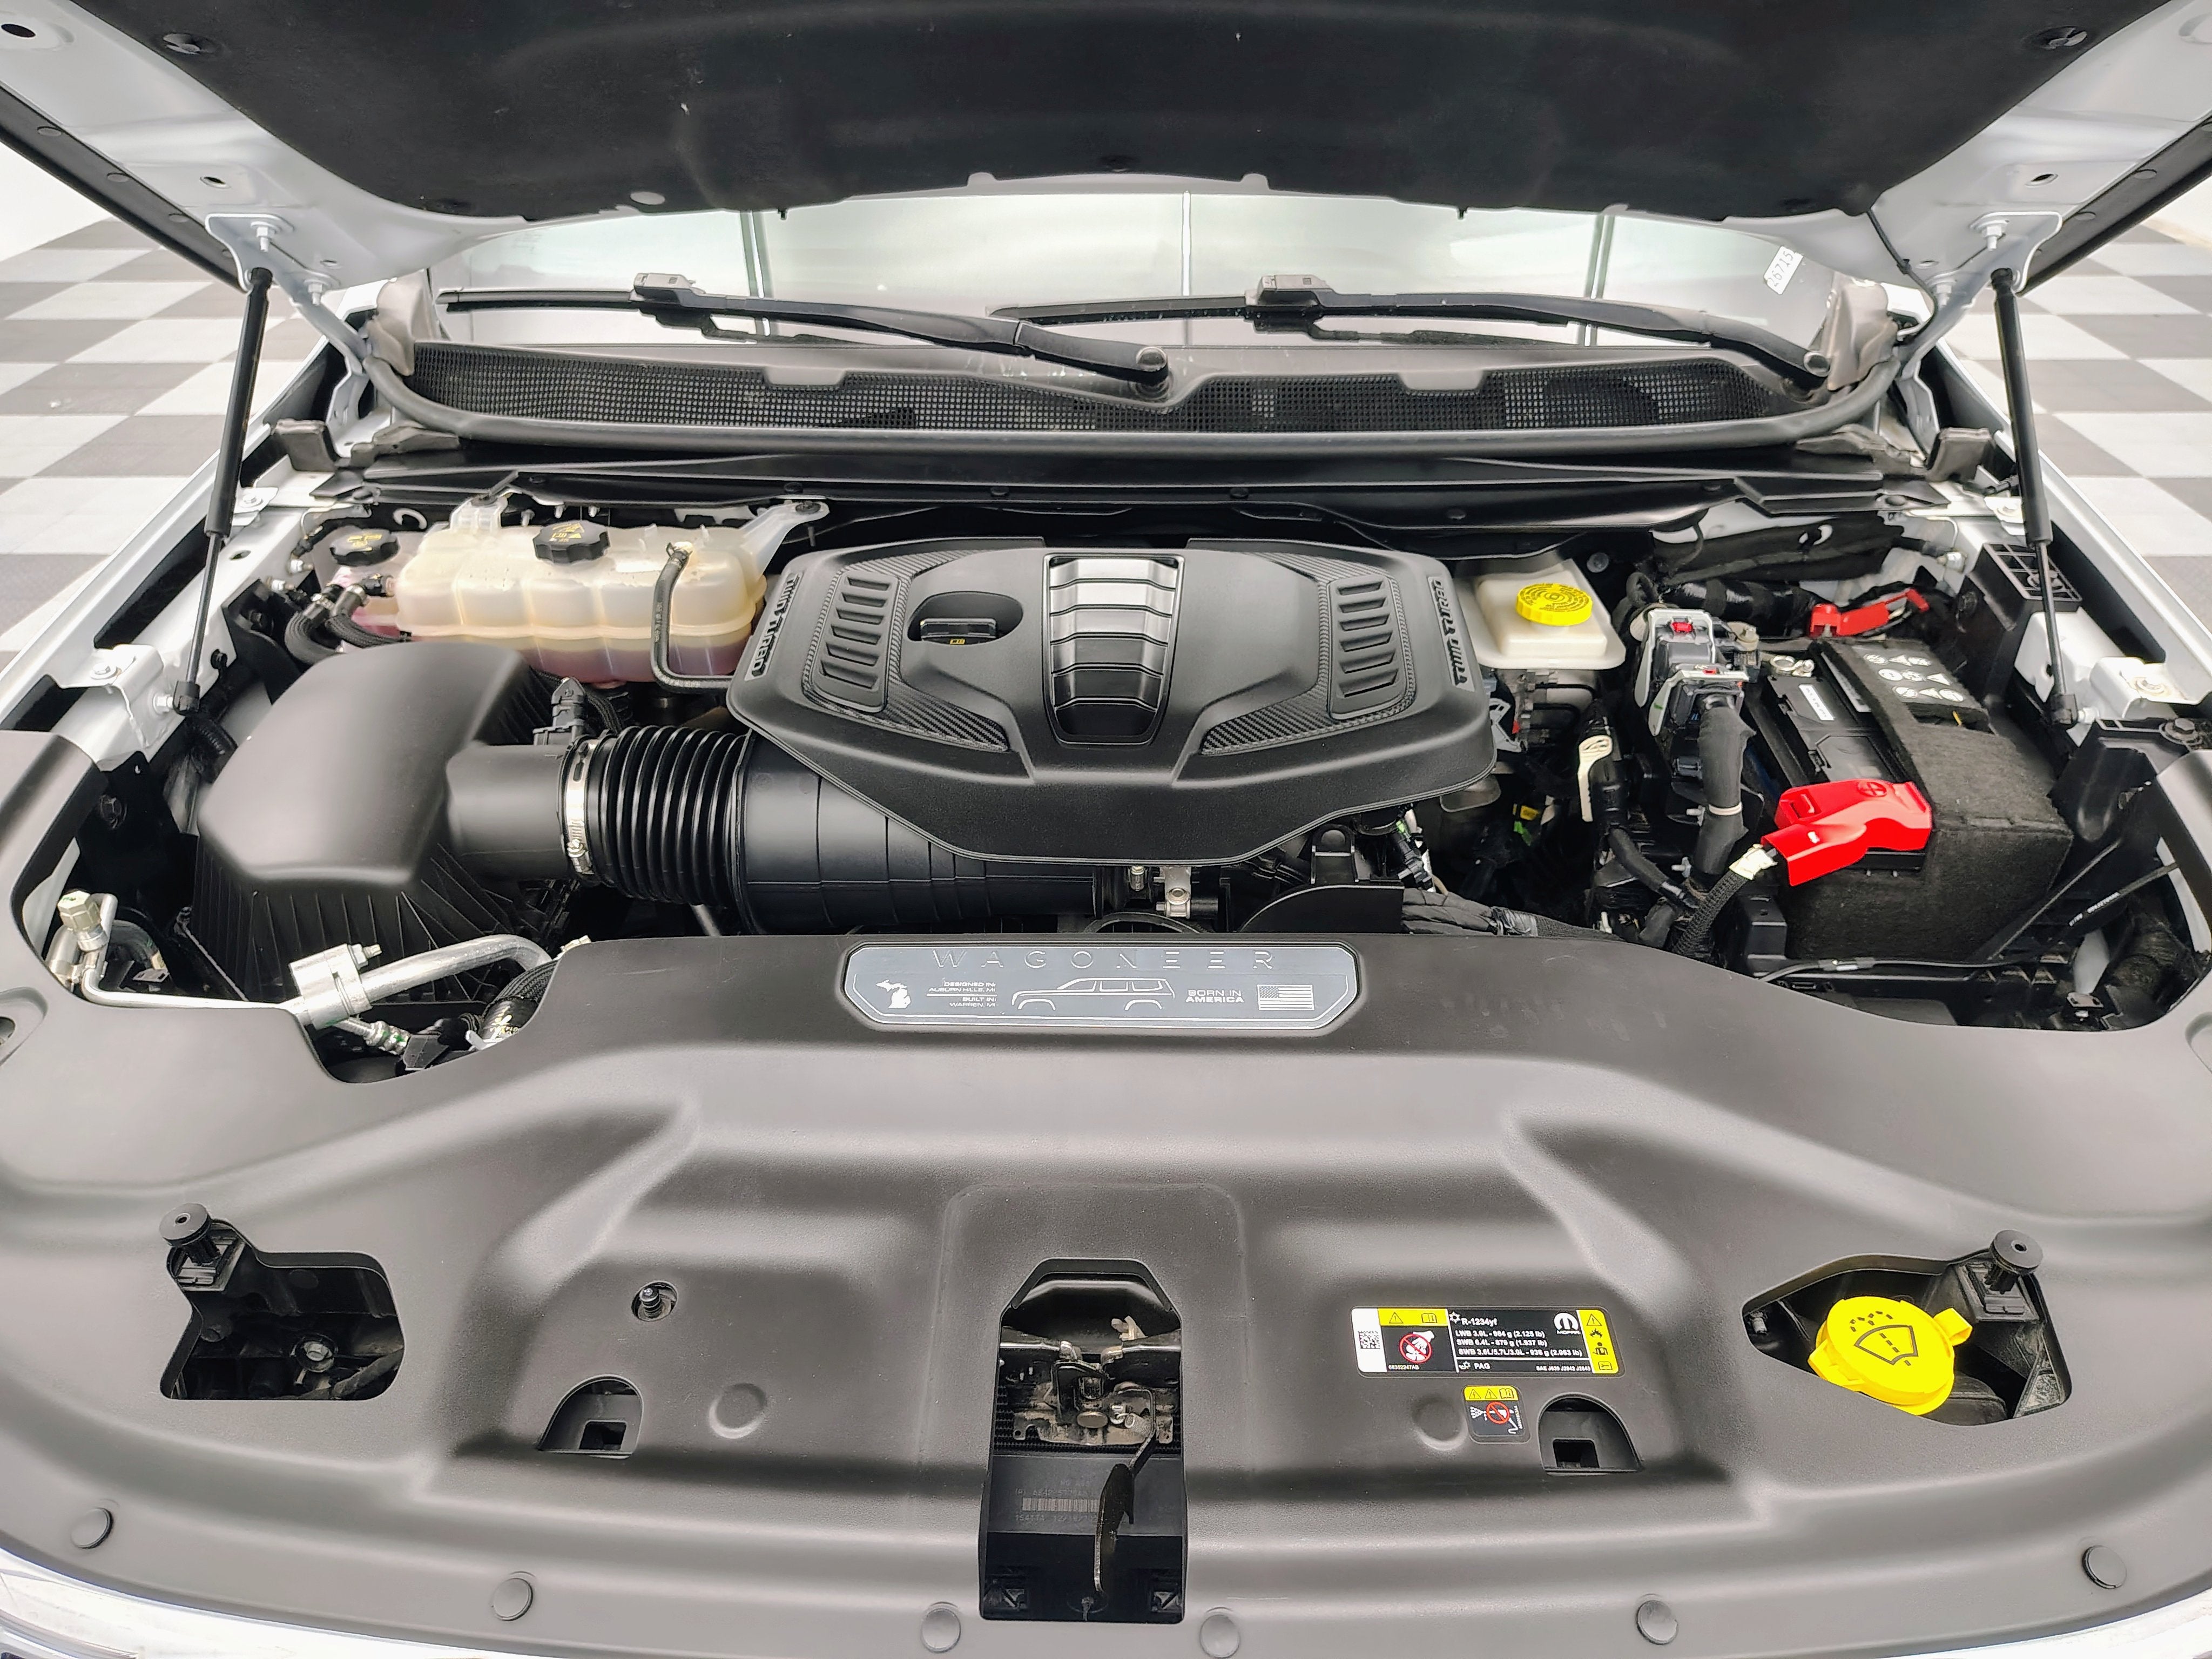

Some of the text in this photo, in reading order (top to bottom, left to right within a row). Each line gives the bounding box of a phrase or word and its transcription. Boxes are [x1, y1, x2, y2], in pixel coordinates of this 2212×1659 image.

[1767, 251, 1794, 287] 26715
[1432, 579, 1455, 635] TURBO
[751, 615, 783, 677] TURBO
[933, 949, 1273, 969] WAGONEER
[1461, 1318, 1498, 1327] R-1234yf
